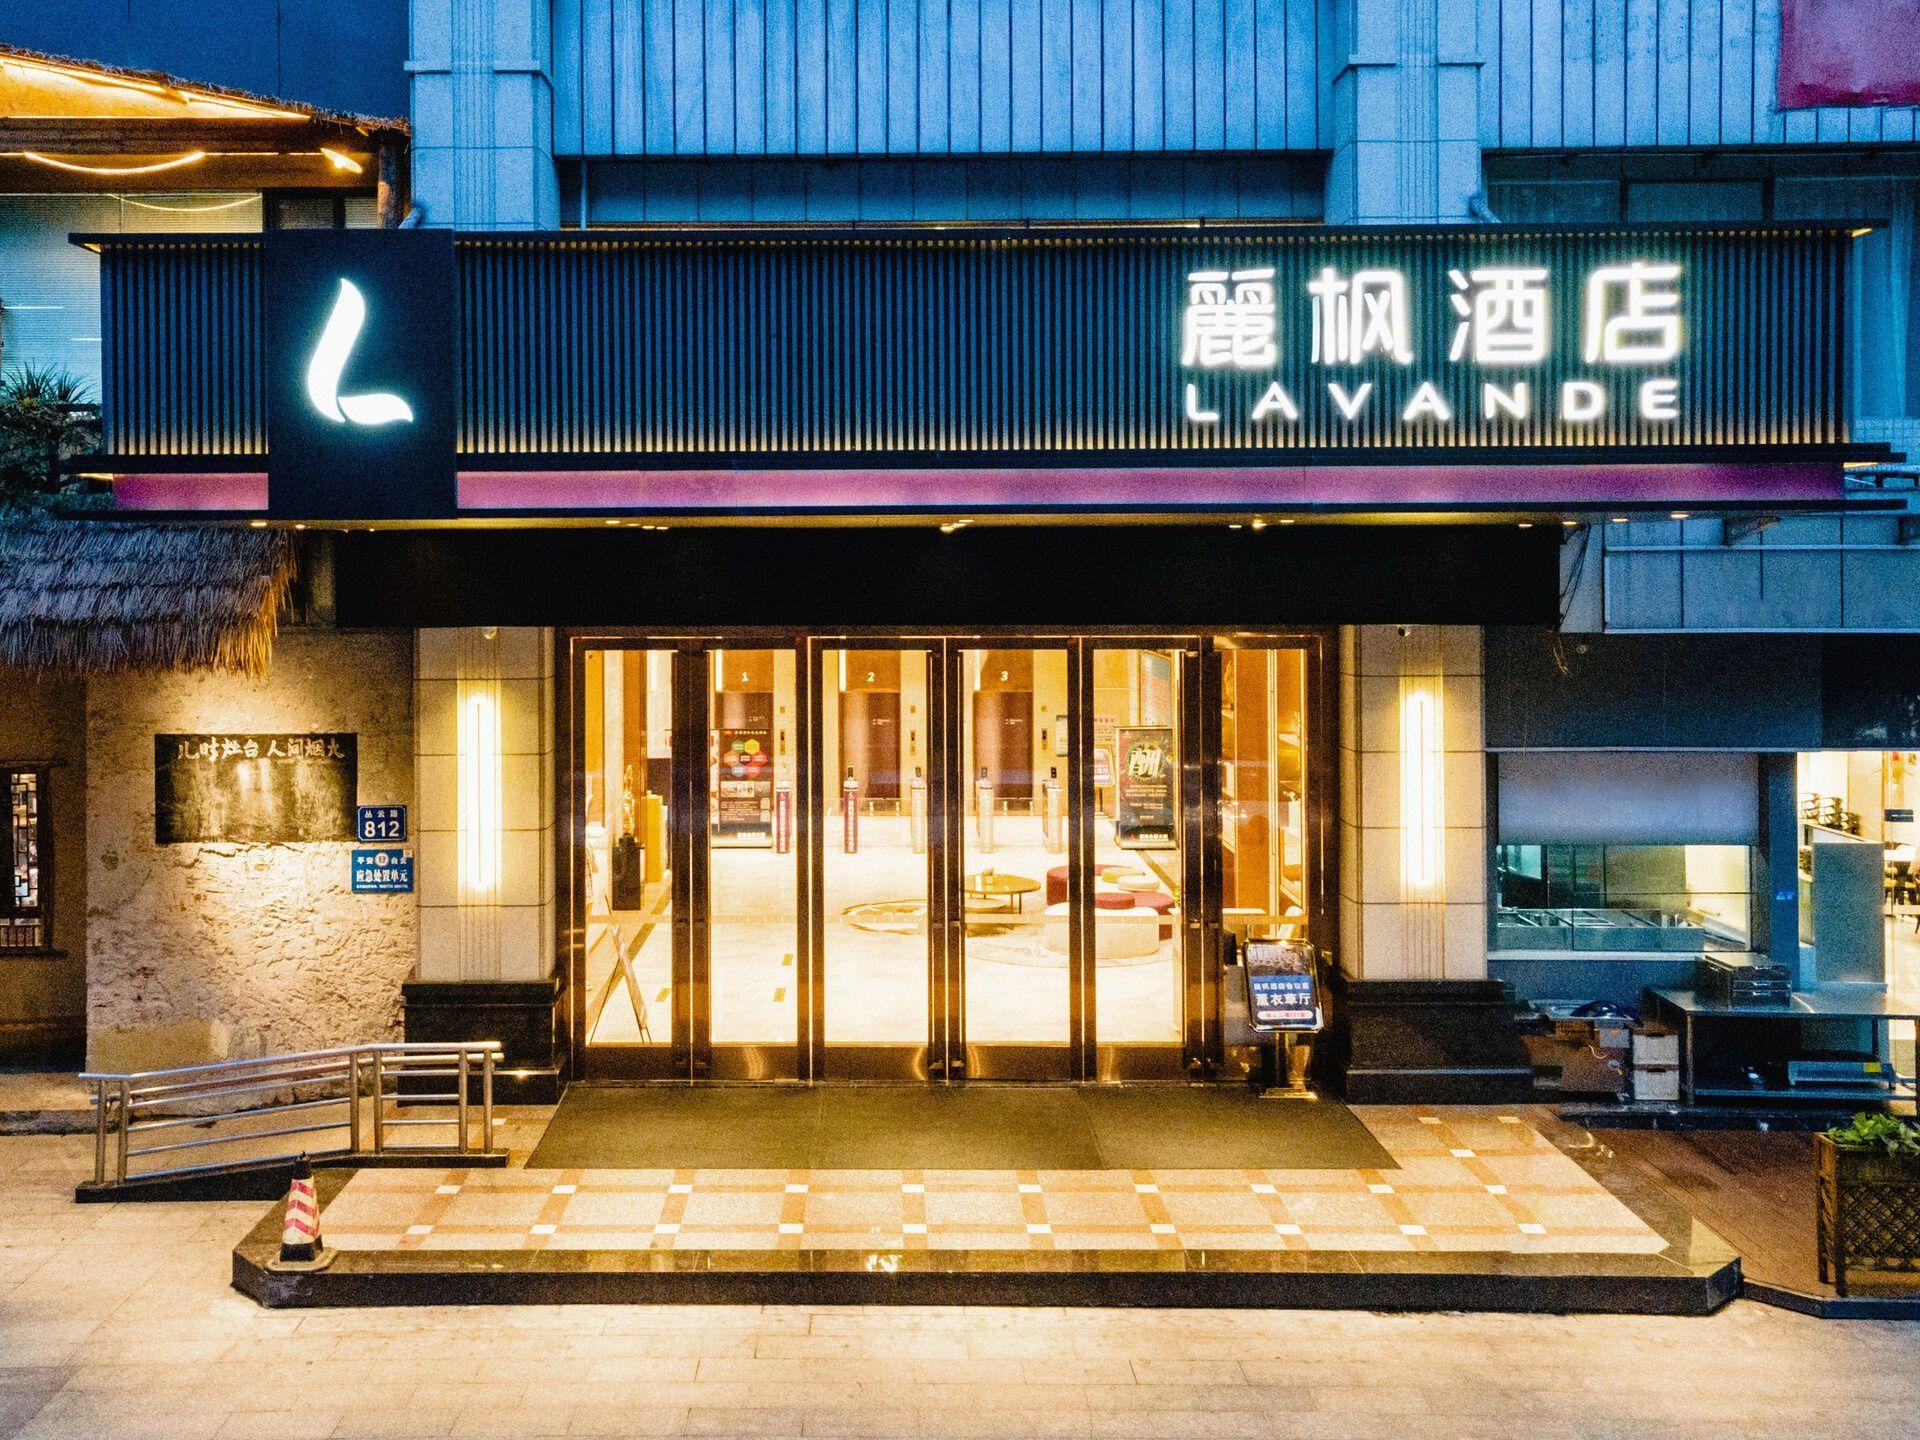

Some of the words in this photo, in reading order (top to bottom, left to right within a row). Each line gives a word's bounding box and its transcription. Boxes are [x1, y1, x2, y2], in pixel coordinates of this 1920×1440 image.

[1182, 262, 1683, 368] 麗枫酒店
[1185, 379, 1680, 421] LAVANDE
[741, 671, 750, 682] 1
[867, 672, 876, 682] 2
[1000, 671, 1009, 682] 3
[266, 738, 345, 760] 人间烟火
[364, 820, 400, 838] 812
[356, 868, 408, 882] 应急处置单元
